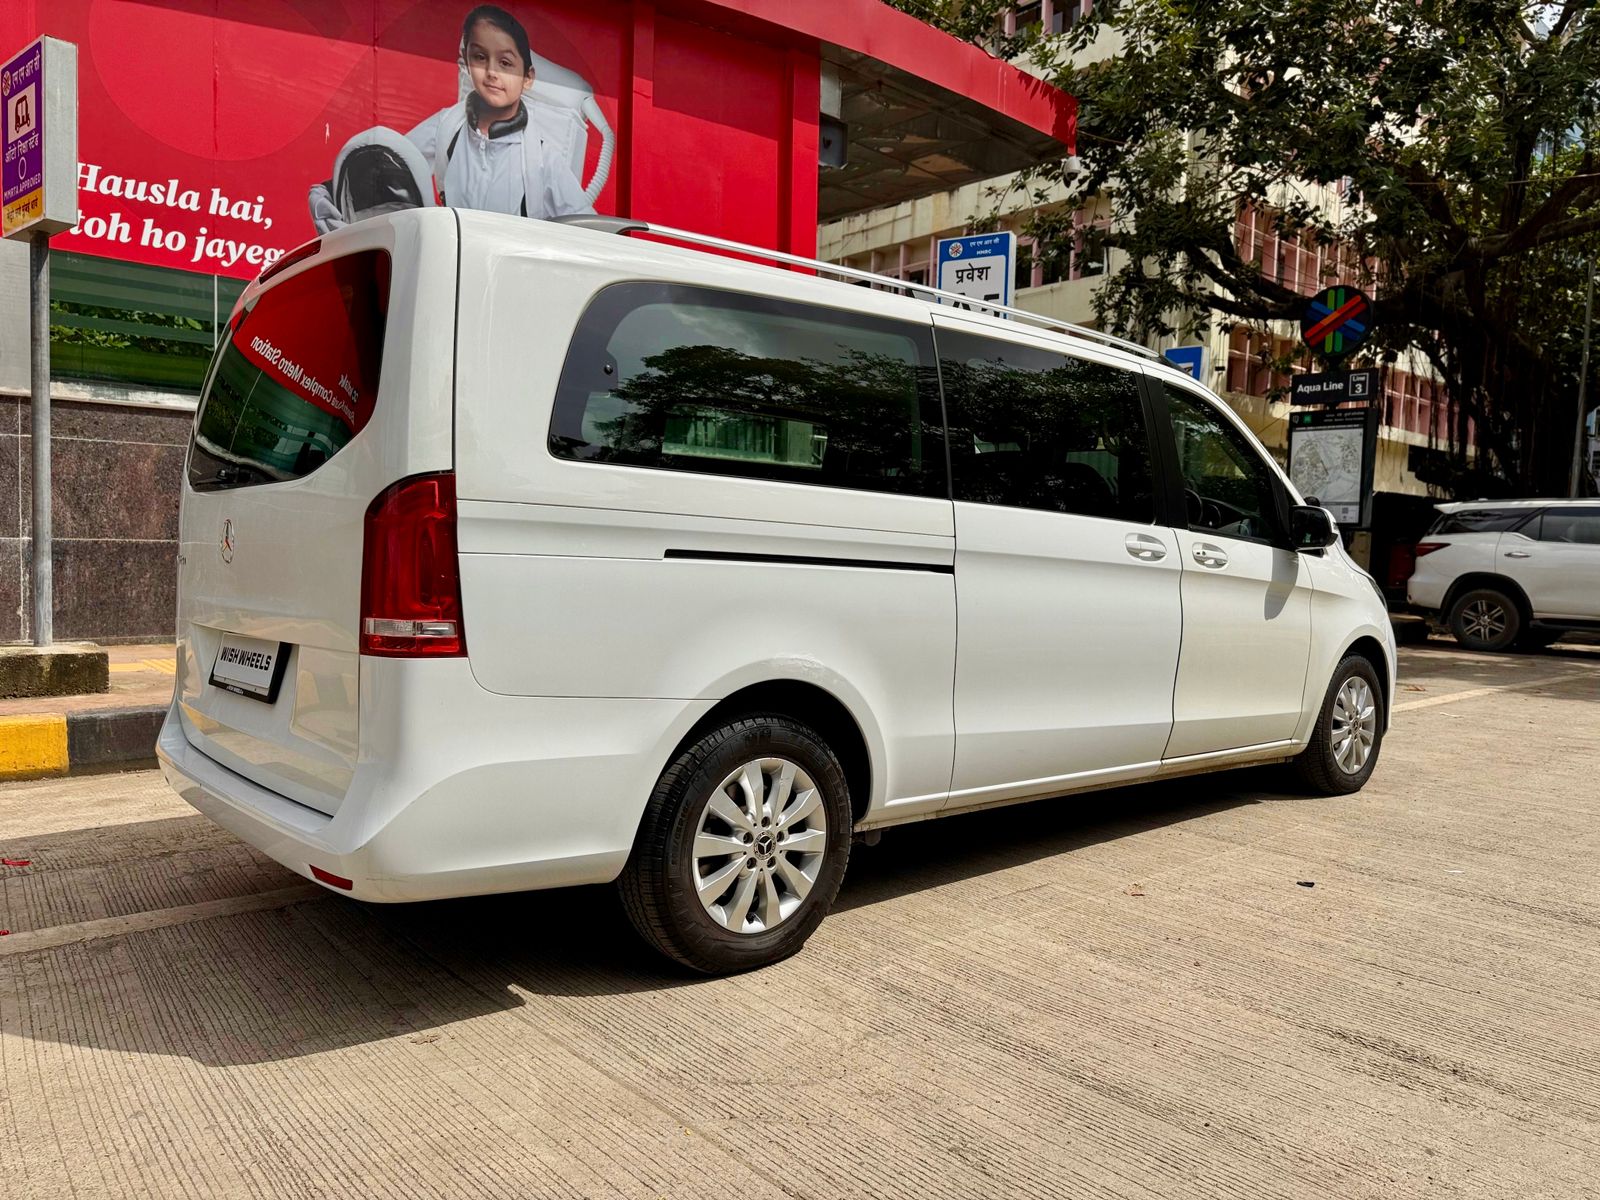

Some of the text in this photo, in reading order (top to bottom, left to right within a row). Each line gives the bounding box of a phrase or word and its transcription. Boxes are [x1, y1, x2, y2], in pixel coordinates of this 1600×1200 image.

[12, 49, 40, 90] एम एम आर सी
[19, 172, 41, 193] APPROVED
[77, 162, 273, 230] Hausla hai,
[69, 209, 285, 272] toh ho jayeg
[955, 262, 991, 284] प्रवेश
[1297, 381, 1344, 394] Aqua Line
[1355, 383, 1363, 394] 3
[220, 646, 272, 671] WISH WHEELS
